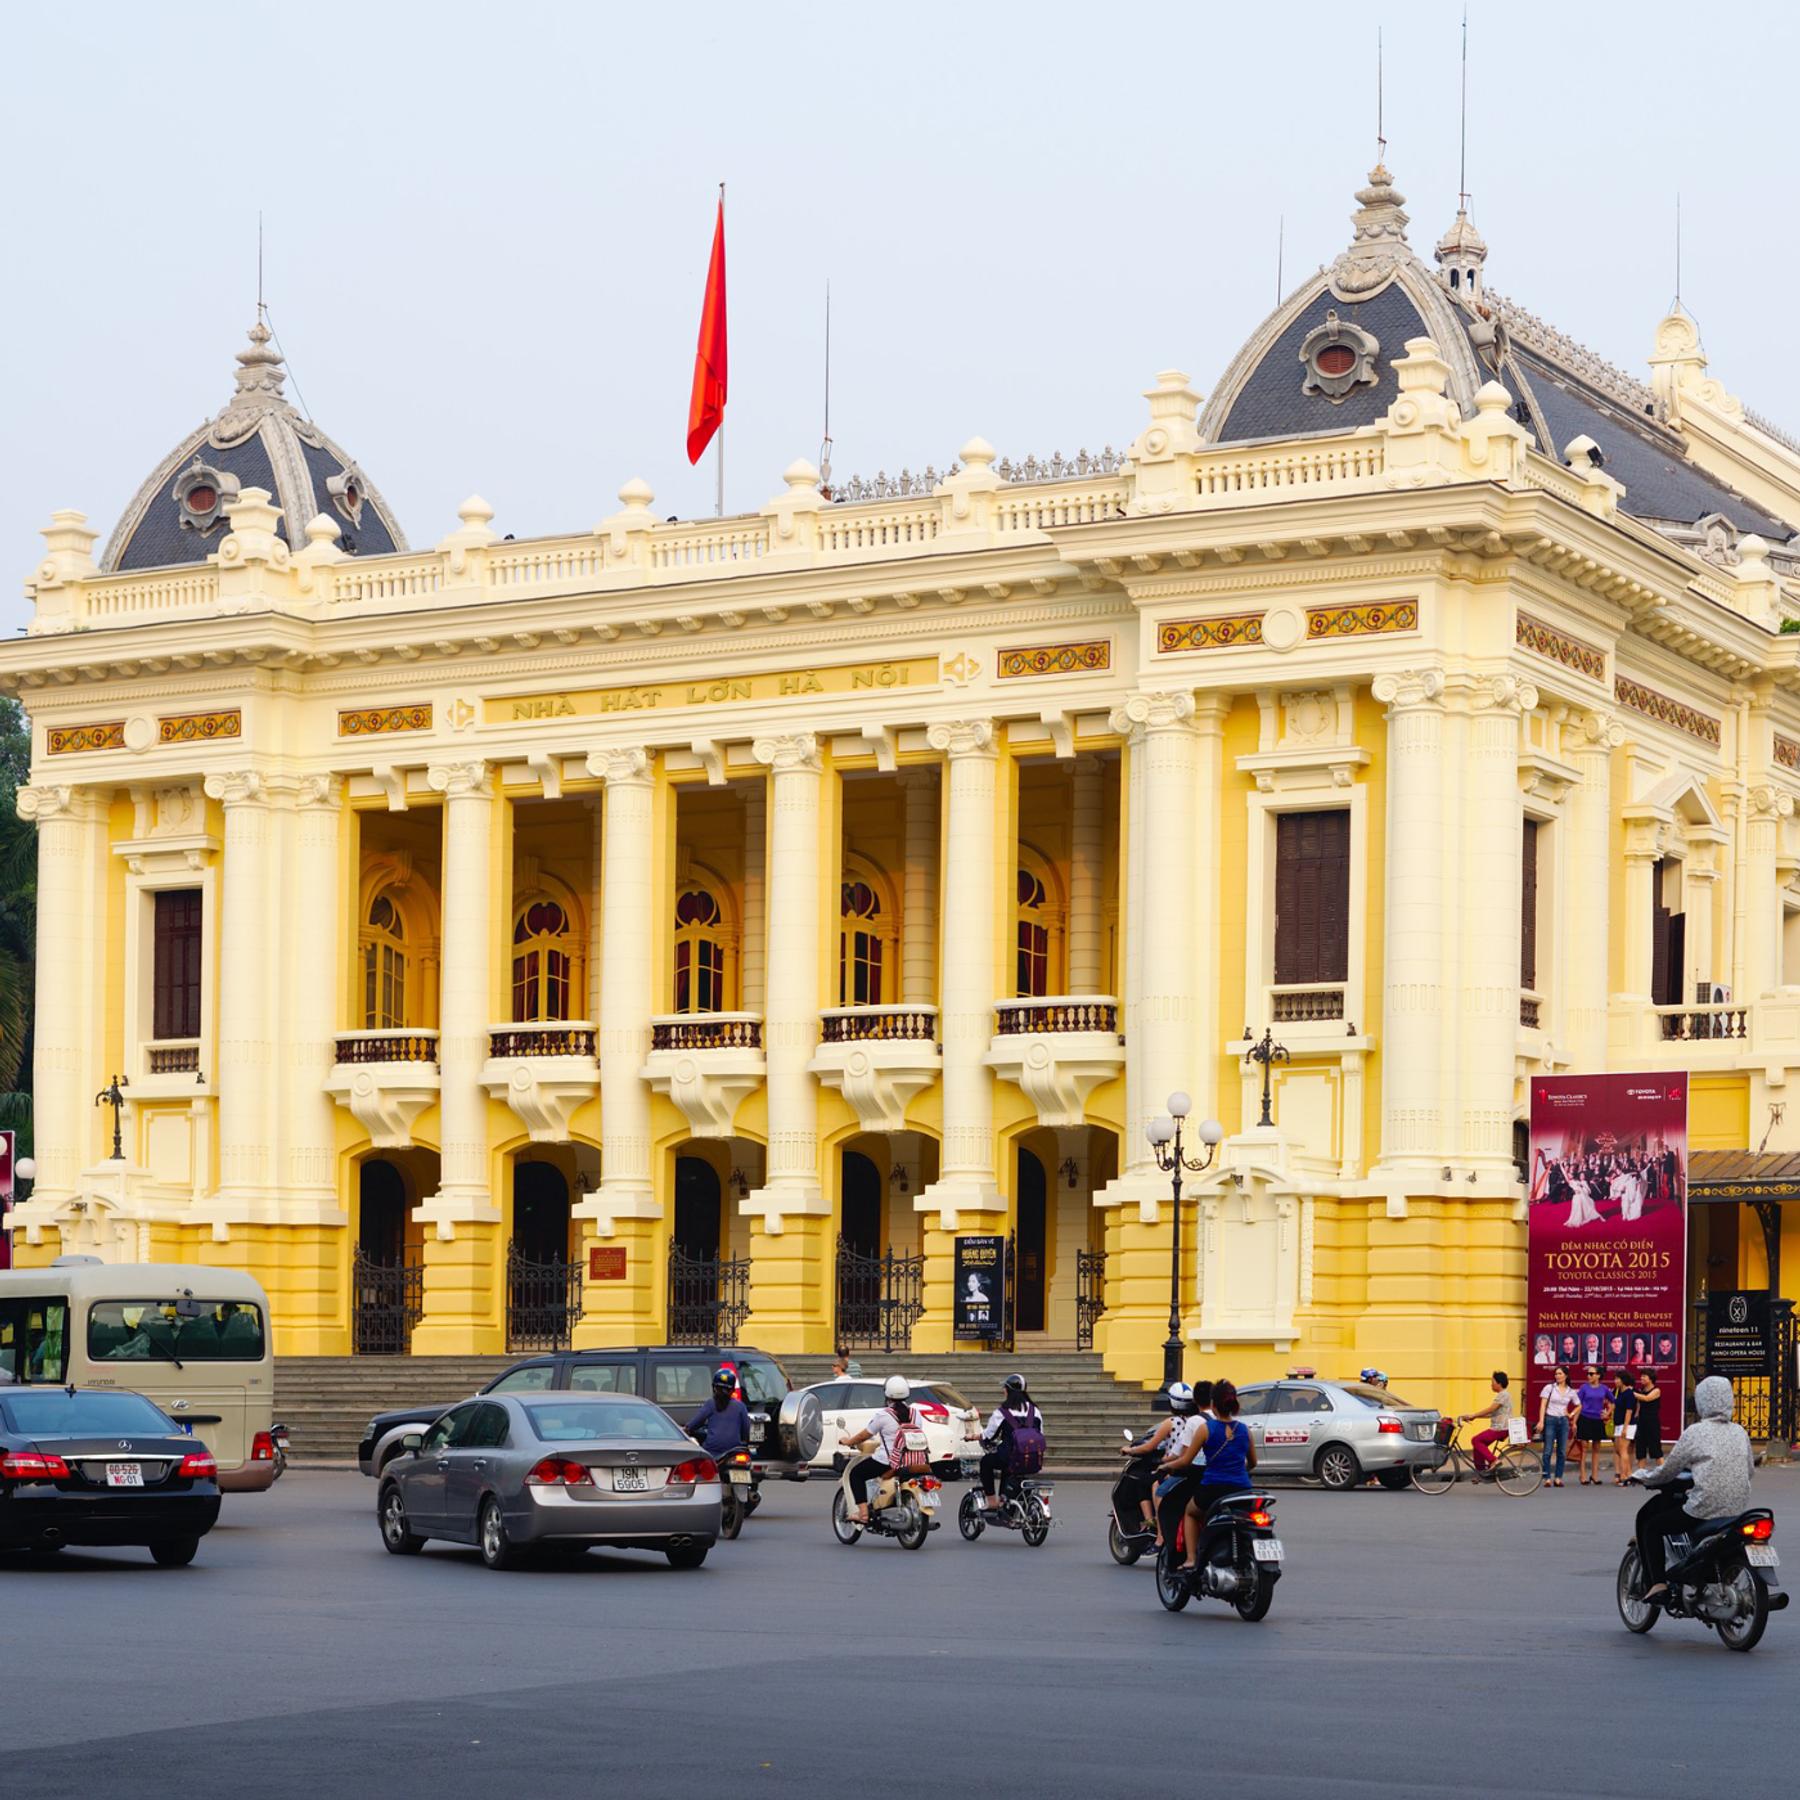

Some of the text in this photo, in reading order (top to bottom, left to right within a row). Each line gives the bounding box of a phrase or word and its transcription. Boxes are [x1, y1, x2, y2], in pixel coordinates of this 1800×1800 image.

[512, 695, 576, 720] NHÀ
[601, 686, 662, 712] HÁT
[779, 671, 824, 695] HÀ
[852, 663, 909, 689] NỘI
[1584, 1241, 1612, 1251] NHẠC
[1544, 1252, 1671, 1269] TOYOTA 2015
[1558, 1270, 1657, 1280] TOYOTA CLASSICS 2015
[1539, 1311, 1673, 1321] NHÀ HÁT NHẠC KỊCH BUDAPEST
[1719, 1326, 1749, 1334] nineteen
[621, 1468, 639, 1480] 19N
